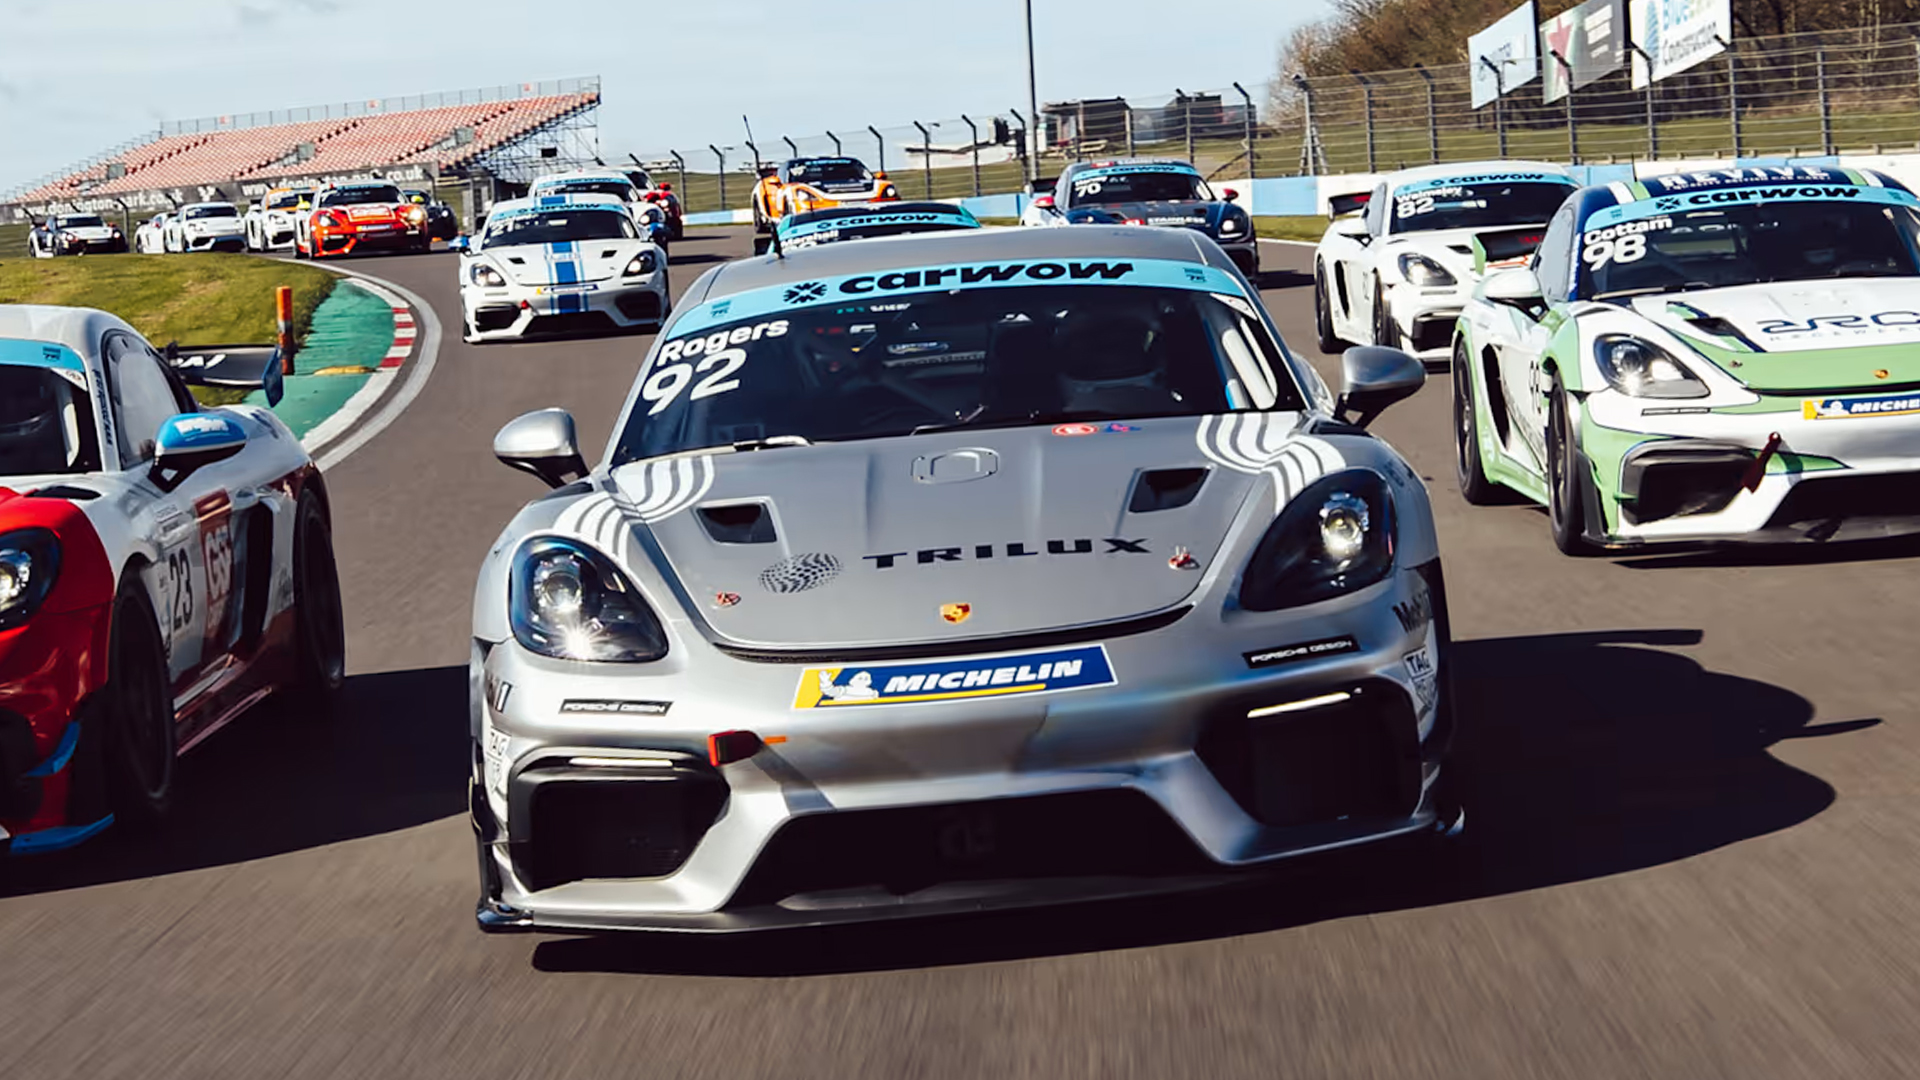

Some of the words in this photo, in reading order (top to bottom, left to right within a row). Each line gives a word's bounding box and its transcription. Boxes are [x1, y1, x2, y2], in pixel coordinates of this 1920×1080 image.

[1449, 173, 1545, 184] carwow
[1658, 166, 1828, 187] REVIVE
[1075, 183, 1101, 197] 70
[1689, 187, 1860, 205] carwow
[837, 214, 938, 227] carwow
[1397, 197, 1435, 218] 82
[1583, 216, 1673, 246] Cottam
[1582, 234, 1647, 272] 98
[838, 261, 1134, 294] carwow
[656, 319, 789, 367] Rogers
[642, 348, 747, 417] 92
[862, 537, 1151, 569] TRILUX
[169, 547, 193, 630] 23
[1251, 647, 1307, 663] PORSCHE
[1309, 640, 1353, 652] DESIGN
[883, 659, 1083, 694] MICHELIN
[562, 701, 619, 712] PORSCHE
[620, 702, 666, 713] DESIGN
